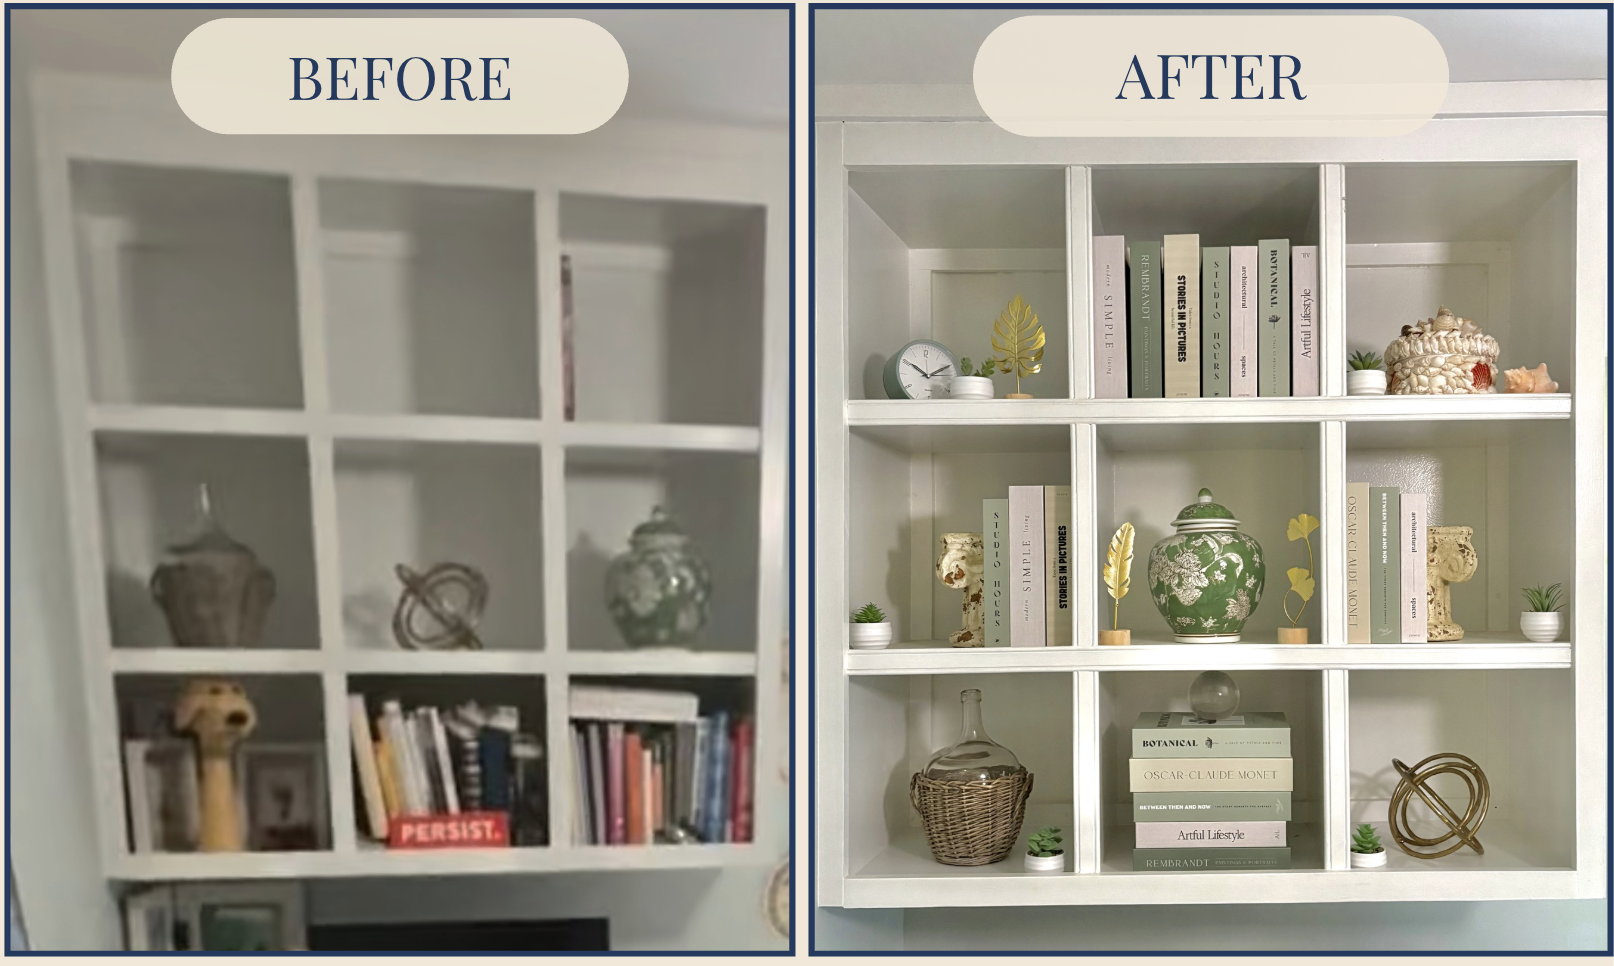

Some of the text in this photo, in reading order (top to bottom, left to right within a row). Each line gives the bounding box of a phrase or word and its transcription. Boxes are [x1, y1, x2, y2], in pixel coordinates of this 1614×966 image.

[1140, 254, 1151, 321] REMBRANDT
[1213, 260, 1221, 320] STUDIO
[1270, 249, 1279, 308] BOTANICAL
[1103, 294, 1114, 349] SIMPLE
[1177, 275, 1187, 363] STORIES IN PICTURES
[1301, 288, 1314, 359] Artful Lifestyle
[1213, 332, 1221, 381] HOURS
[1239, 355, 1247, 378] spaces
[1022, 540, 1032, 592] SIMPLE
[1058, 525, 1067, 609] STORIES IN PICTURES
[1348, 590, 1357, 628] MONET
[1142, 739, 1199, 748] BOTANICAL
[1237, 770, 1278, 780] MONET
[402, 820, 502, 843] PERSIST.
[1177, 829, 1245, 842] Artful Lifestyle
[1146, 859, 1210, 868] REMBRANDT
